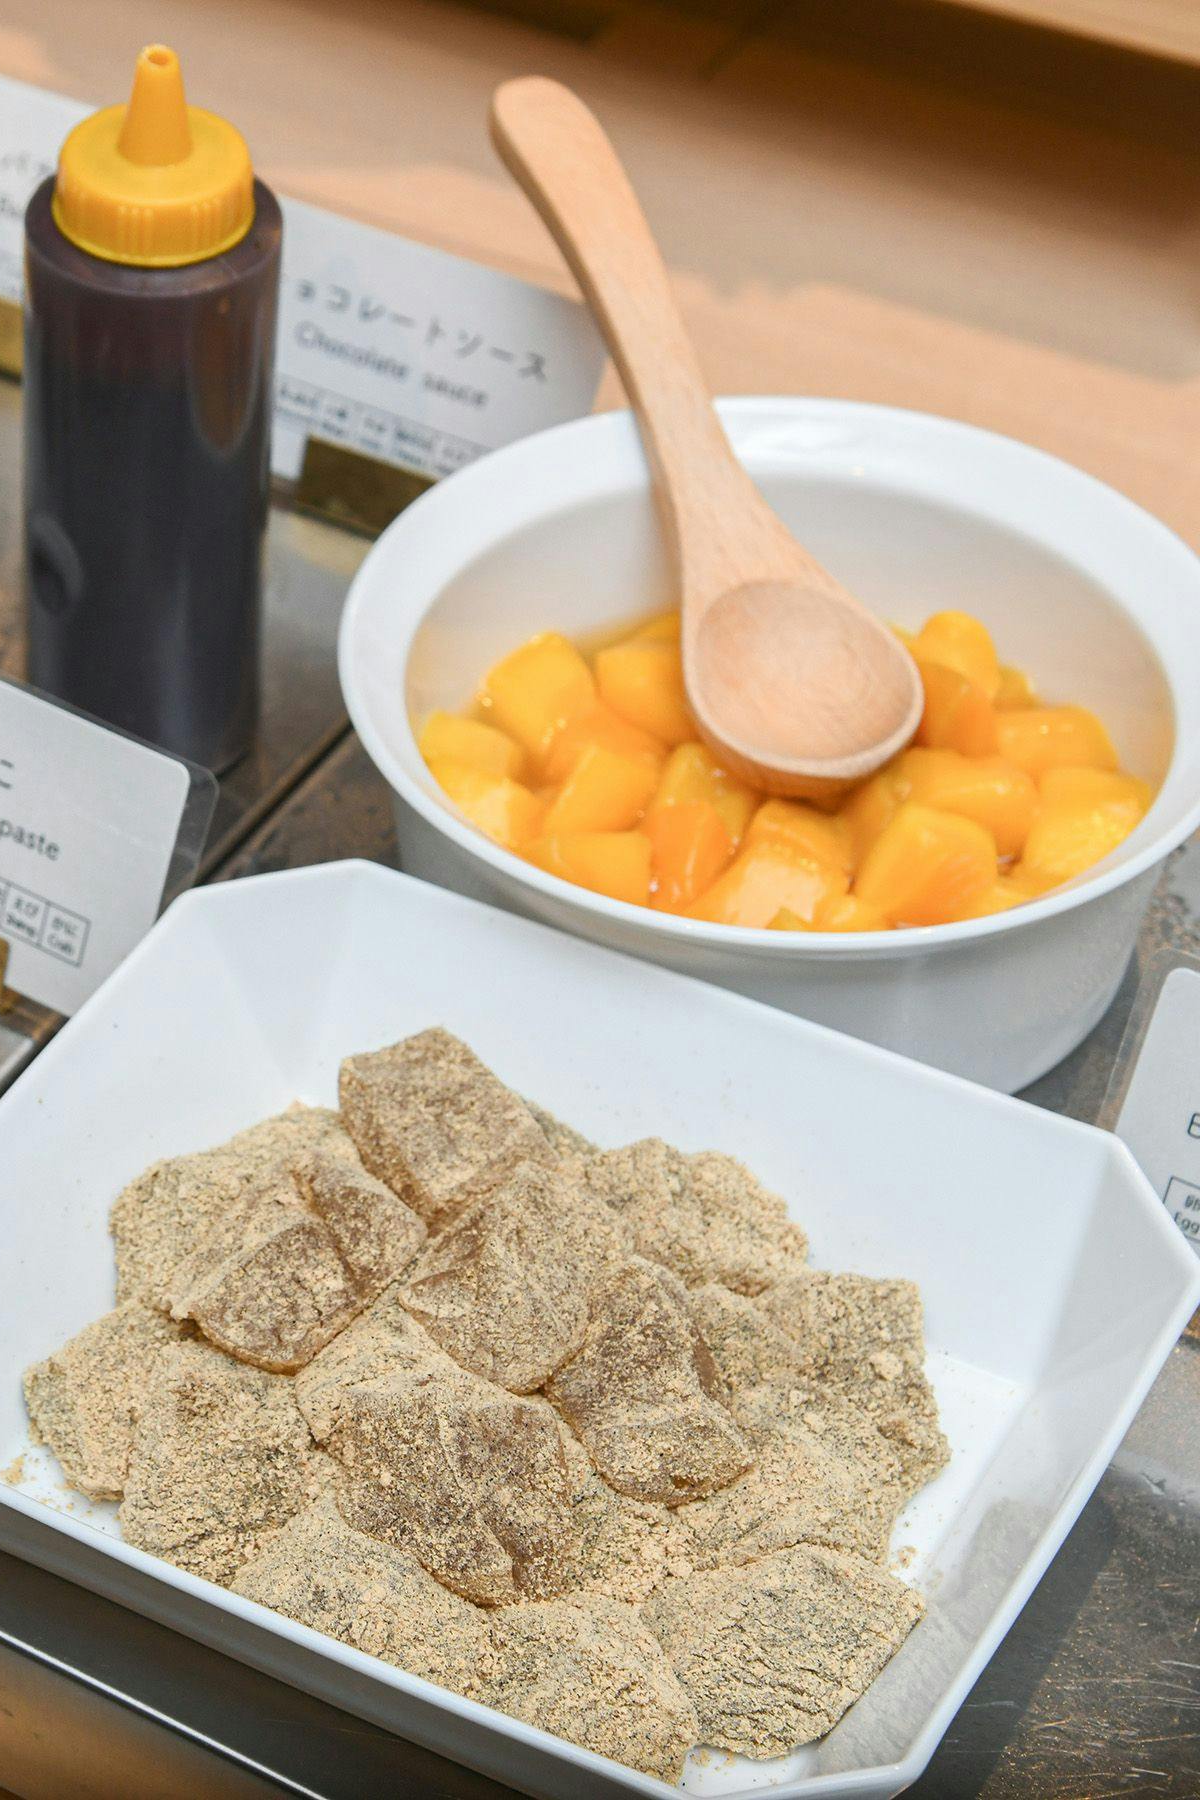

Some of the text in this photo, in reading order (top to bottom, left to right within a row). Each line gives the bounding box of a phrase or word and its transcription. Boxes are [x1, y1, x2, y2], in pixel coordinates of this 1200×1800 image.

[298, 279, 547, 382] ョコレートソース
[422, 374, 488, 408] sauce
